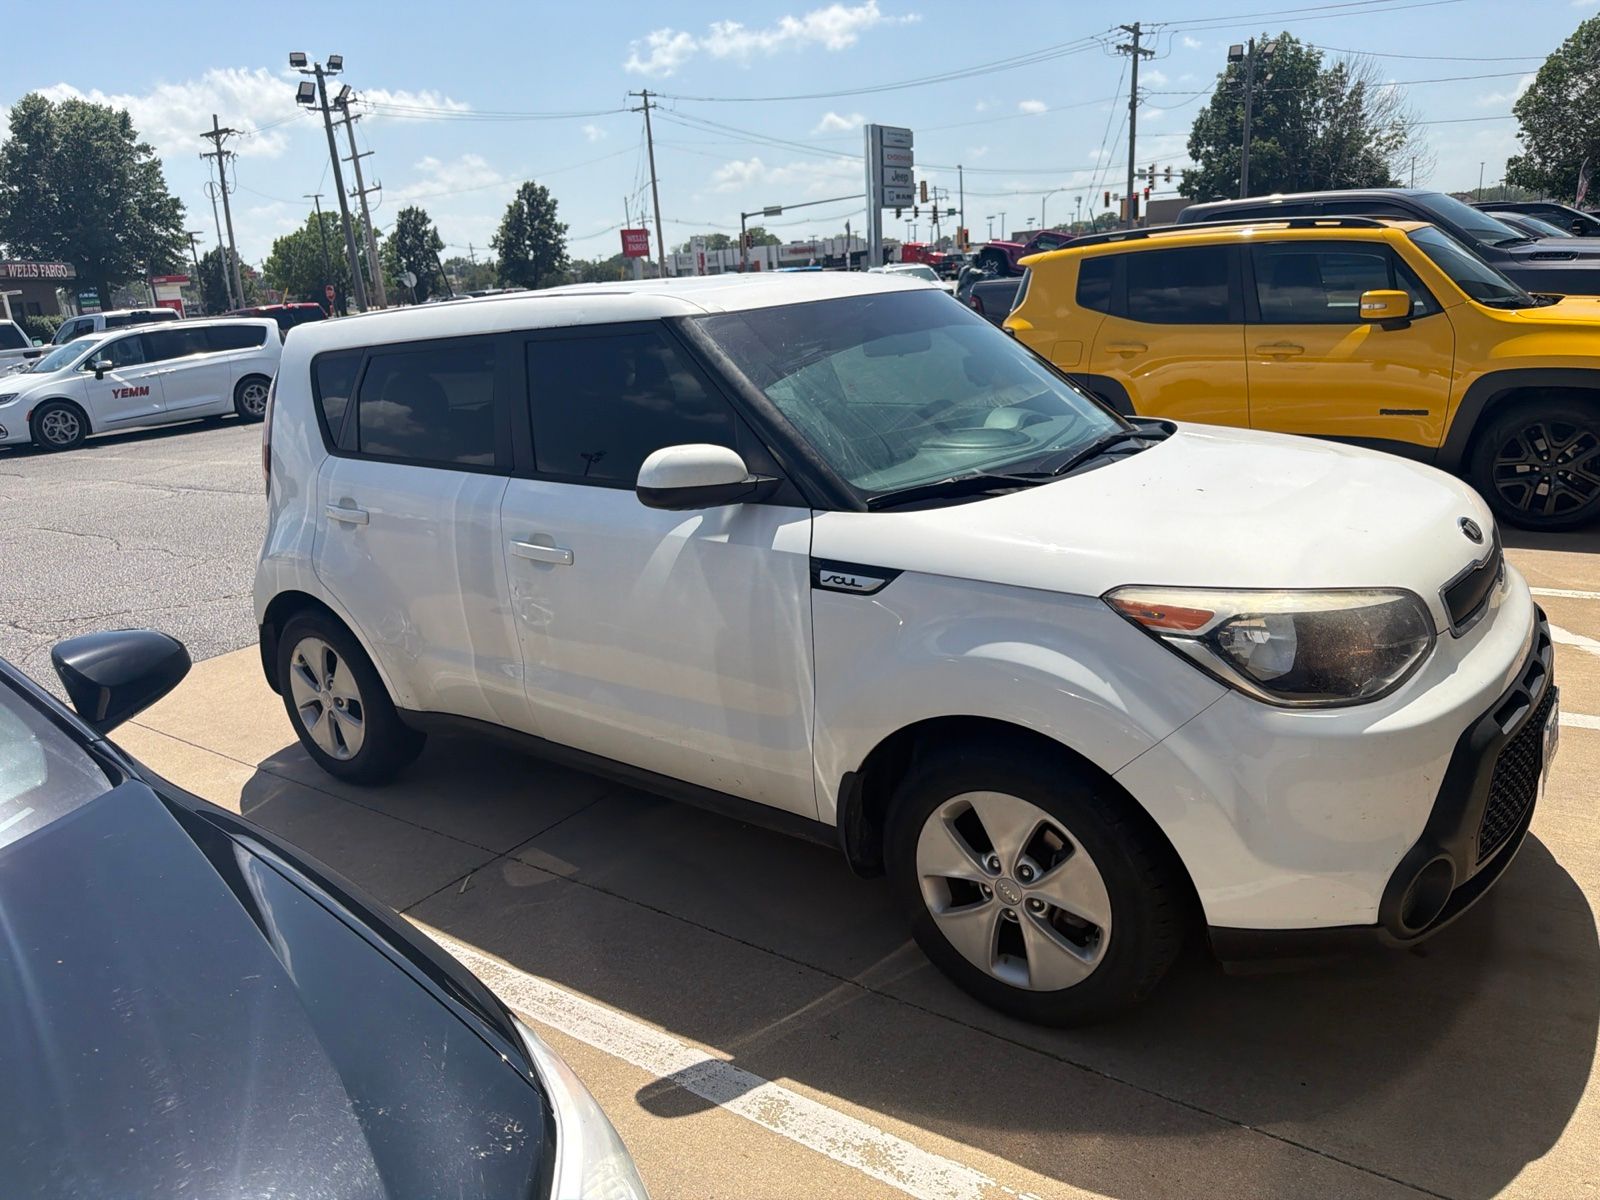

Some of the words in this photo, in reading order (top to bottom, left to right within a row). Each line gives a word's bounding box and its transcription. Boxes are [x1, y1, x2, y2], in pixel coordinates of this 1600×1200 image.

[891, 170, 909, 184] Jeep
[8, 264, 39, 278] WELLS
[40, 264, 68, 278] FARGO
[112, 386, 150, 399] YEMM
